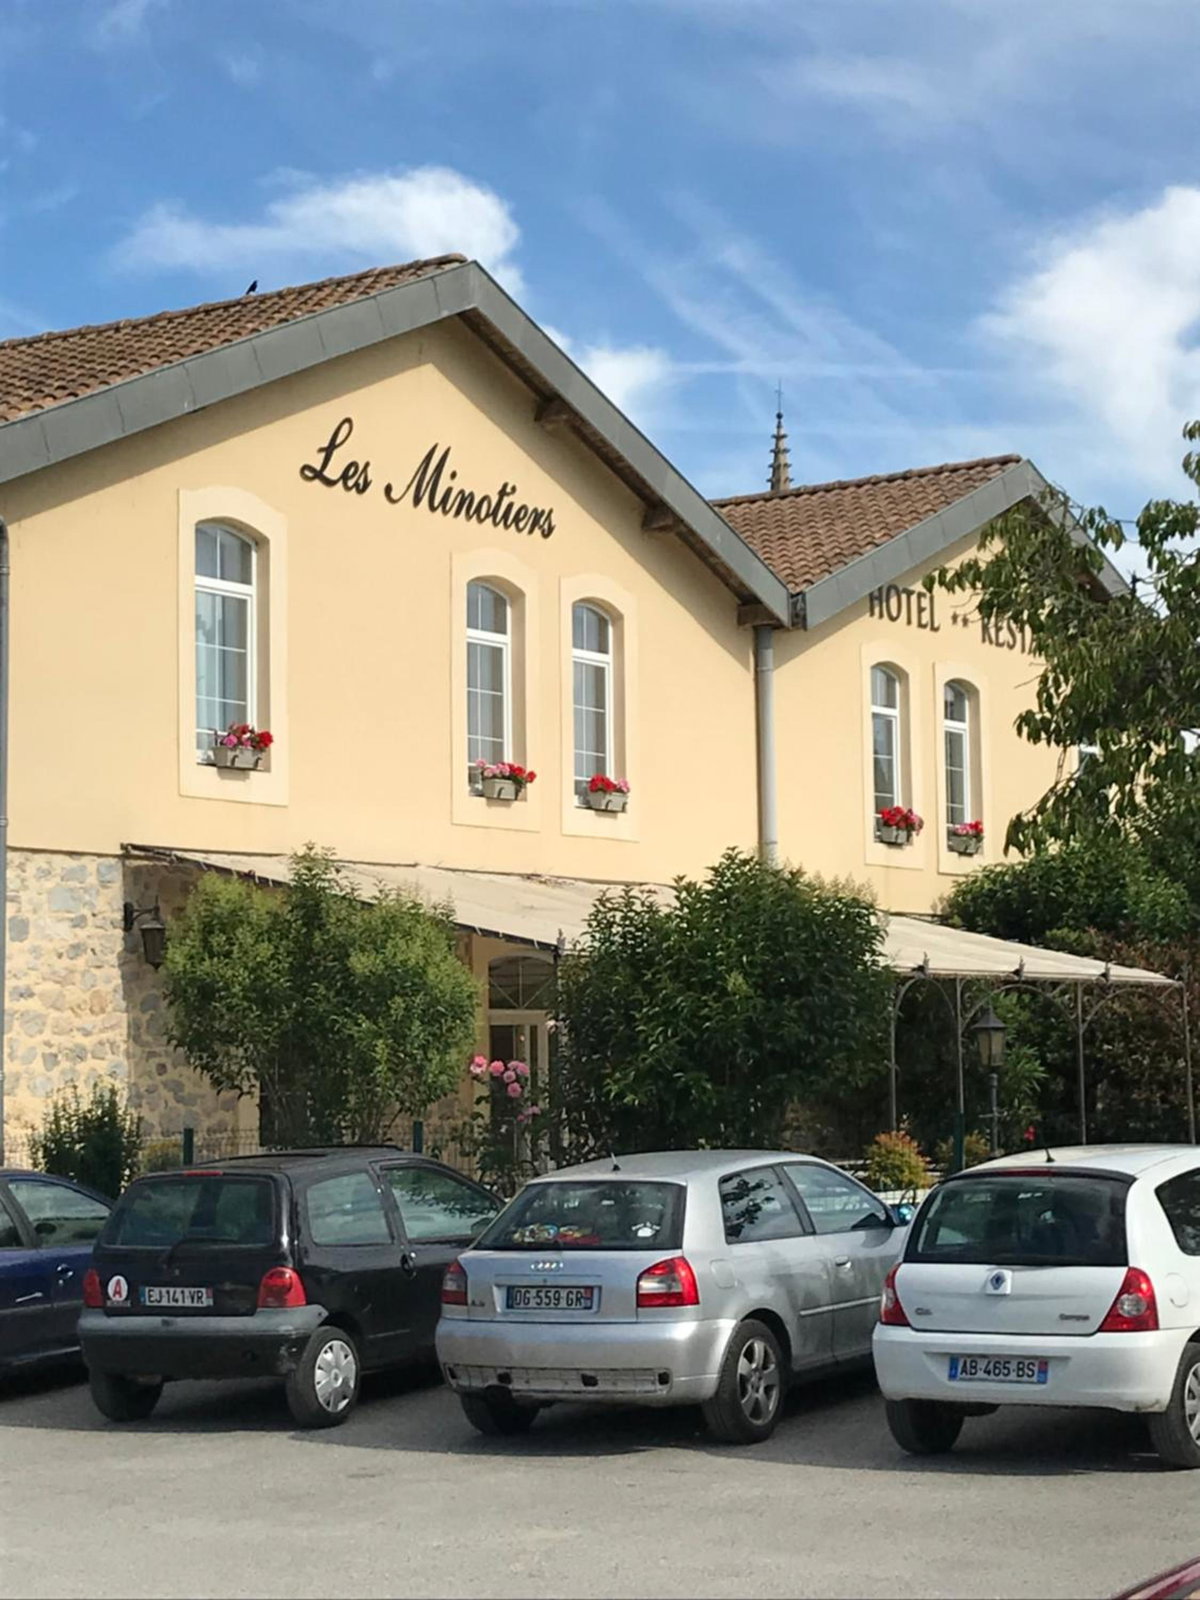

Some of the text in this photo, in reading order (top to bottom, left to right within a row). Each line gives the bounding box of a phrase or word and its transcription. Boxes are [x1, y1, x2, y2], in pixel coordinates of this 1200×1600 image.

[299, 416, 556, 540] Les Minotiers
[868, 583, 941, 633] HOTEL
[112, 1278, 123, 1298] A
